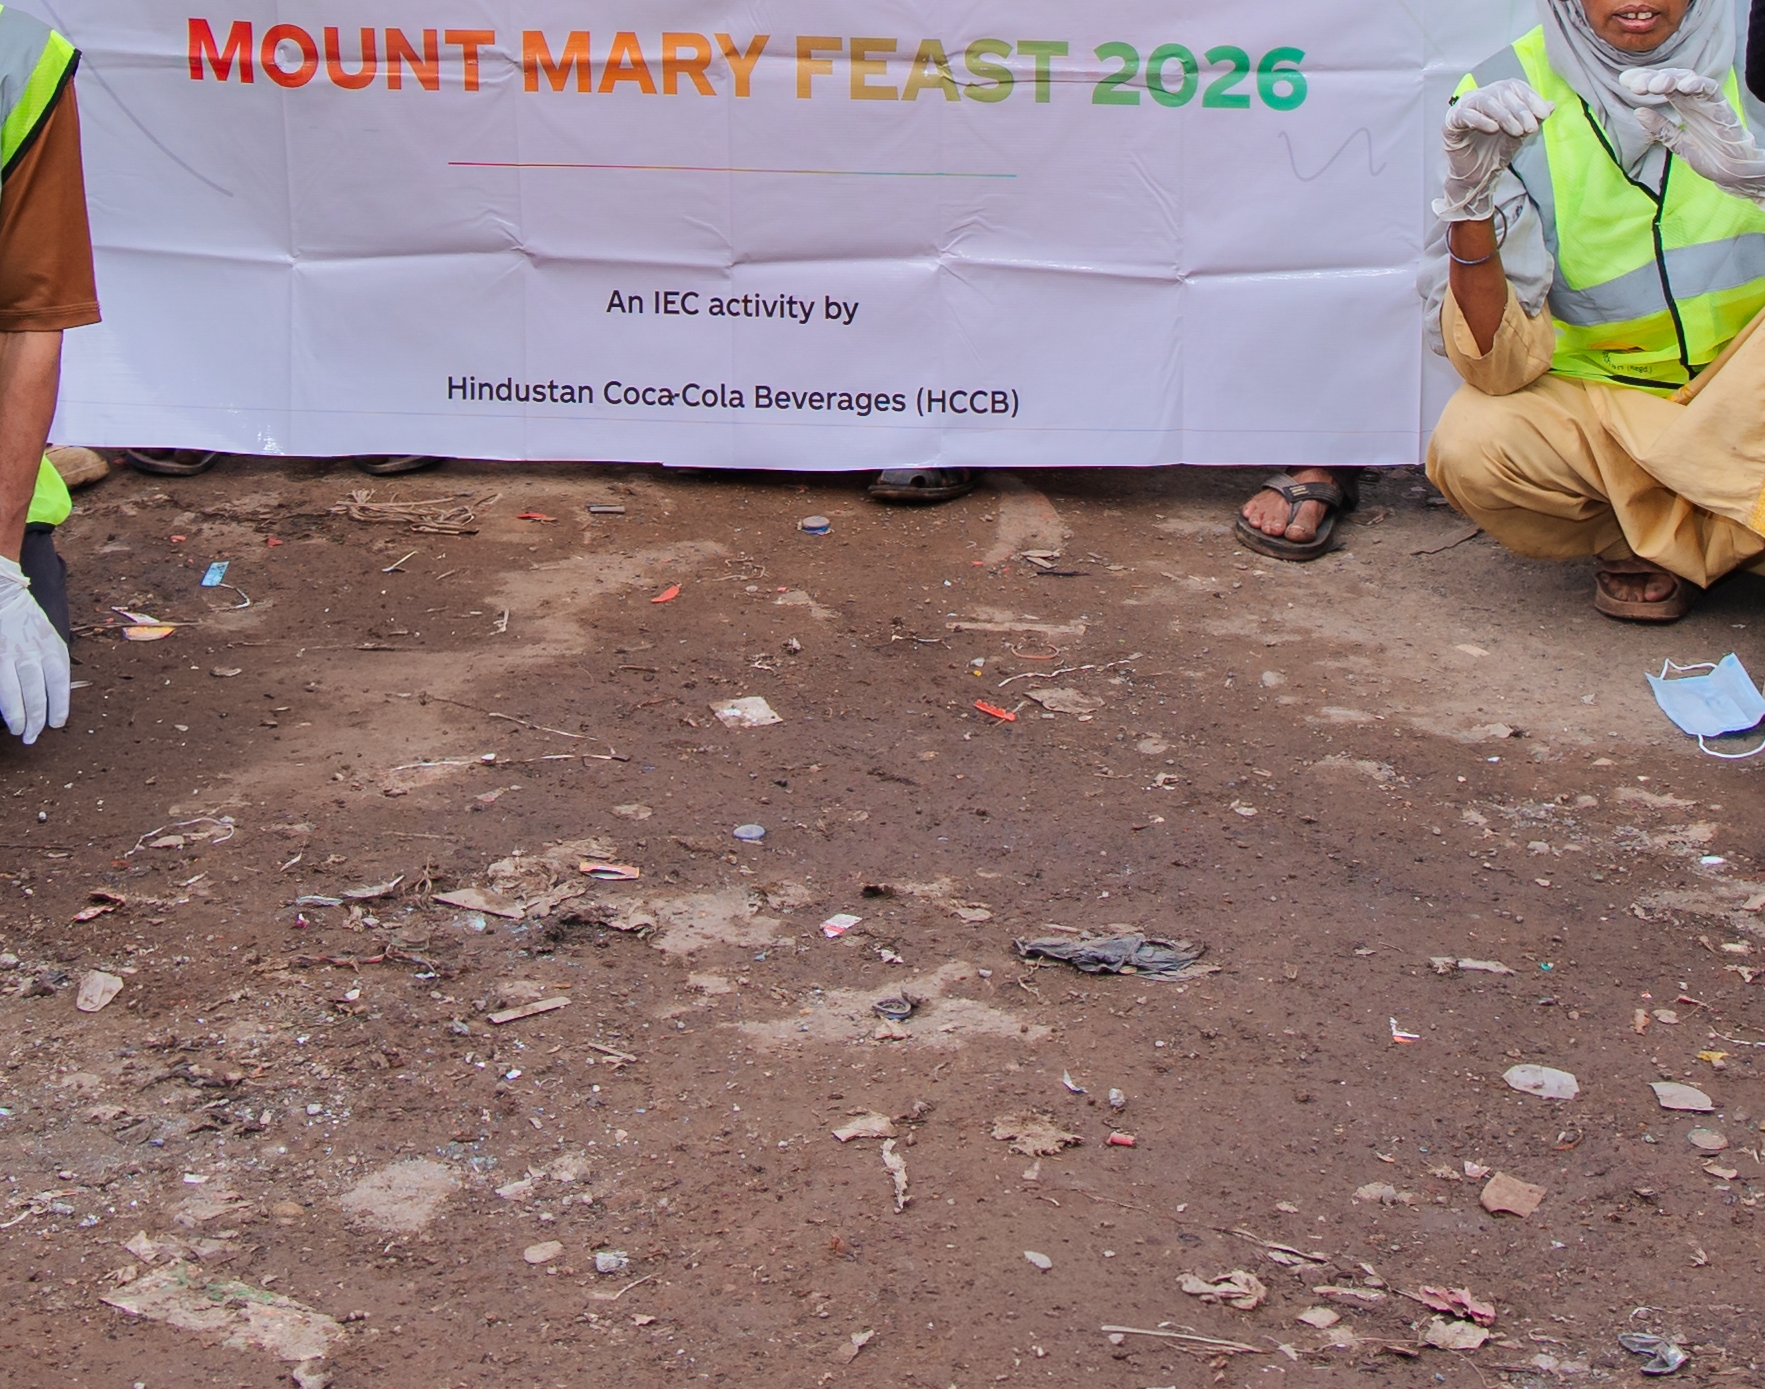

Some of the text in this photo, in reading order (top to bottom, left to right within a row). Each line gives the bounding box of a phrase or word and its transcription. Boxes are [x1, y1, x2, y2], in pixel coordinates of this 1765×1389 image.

[188, 17, 1308, 111] MOUNT MARY FEAST 2026
[606, 289, 859, 325] An IEC activity by
[447, 375, 1020, 418] Hindustan Coca-Cola Beverages (HCCB)
